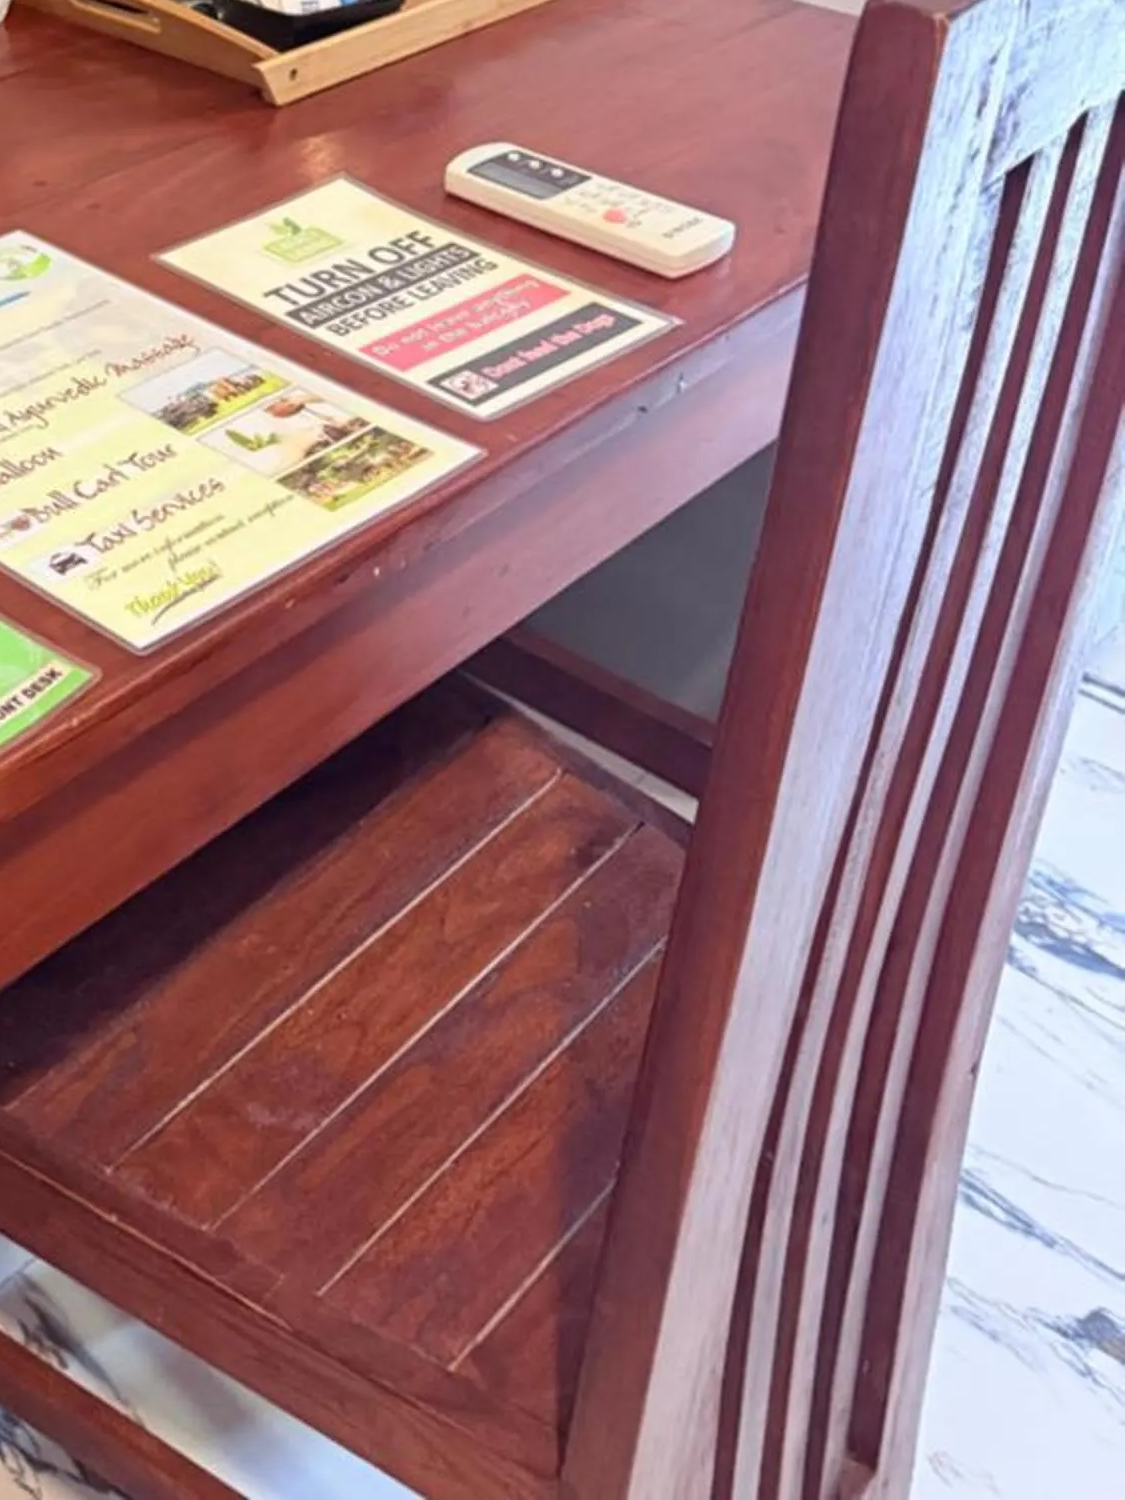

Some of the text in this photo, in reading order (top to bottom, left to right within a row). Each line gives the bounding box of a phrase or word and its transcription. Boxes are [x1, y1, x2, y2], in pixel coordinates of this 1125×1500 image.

[263, 230, 434, 306] TURN OFF
[300, 246, 470, 324] AIRCON & LIGHTS
[326, 258, 498, 336] BEFORE LEAVING
[3, 376, 107, 430] Ayurvedic
[21, 443, 178, 523] Bull Cart Tour
[74, 478, 224, 554] Taxi Services
[20, 667, 63, 700] DESK
